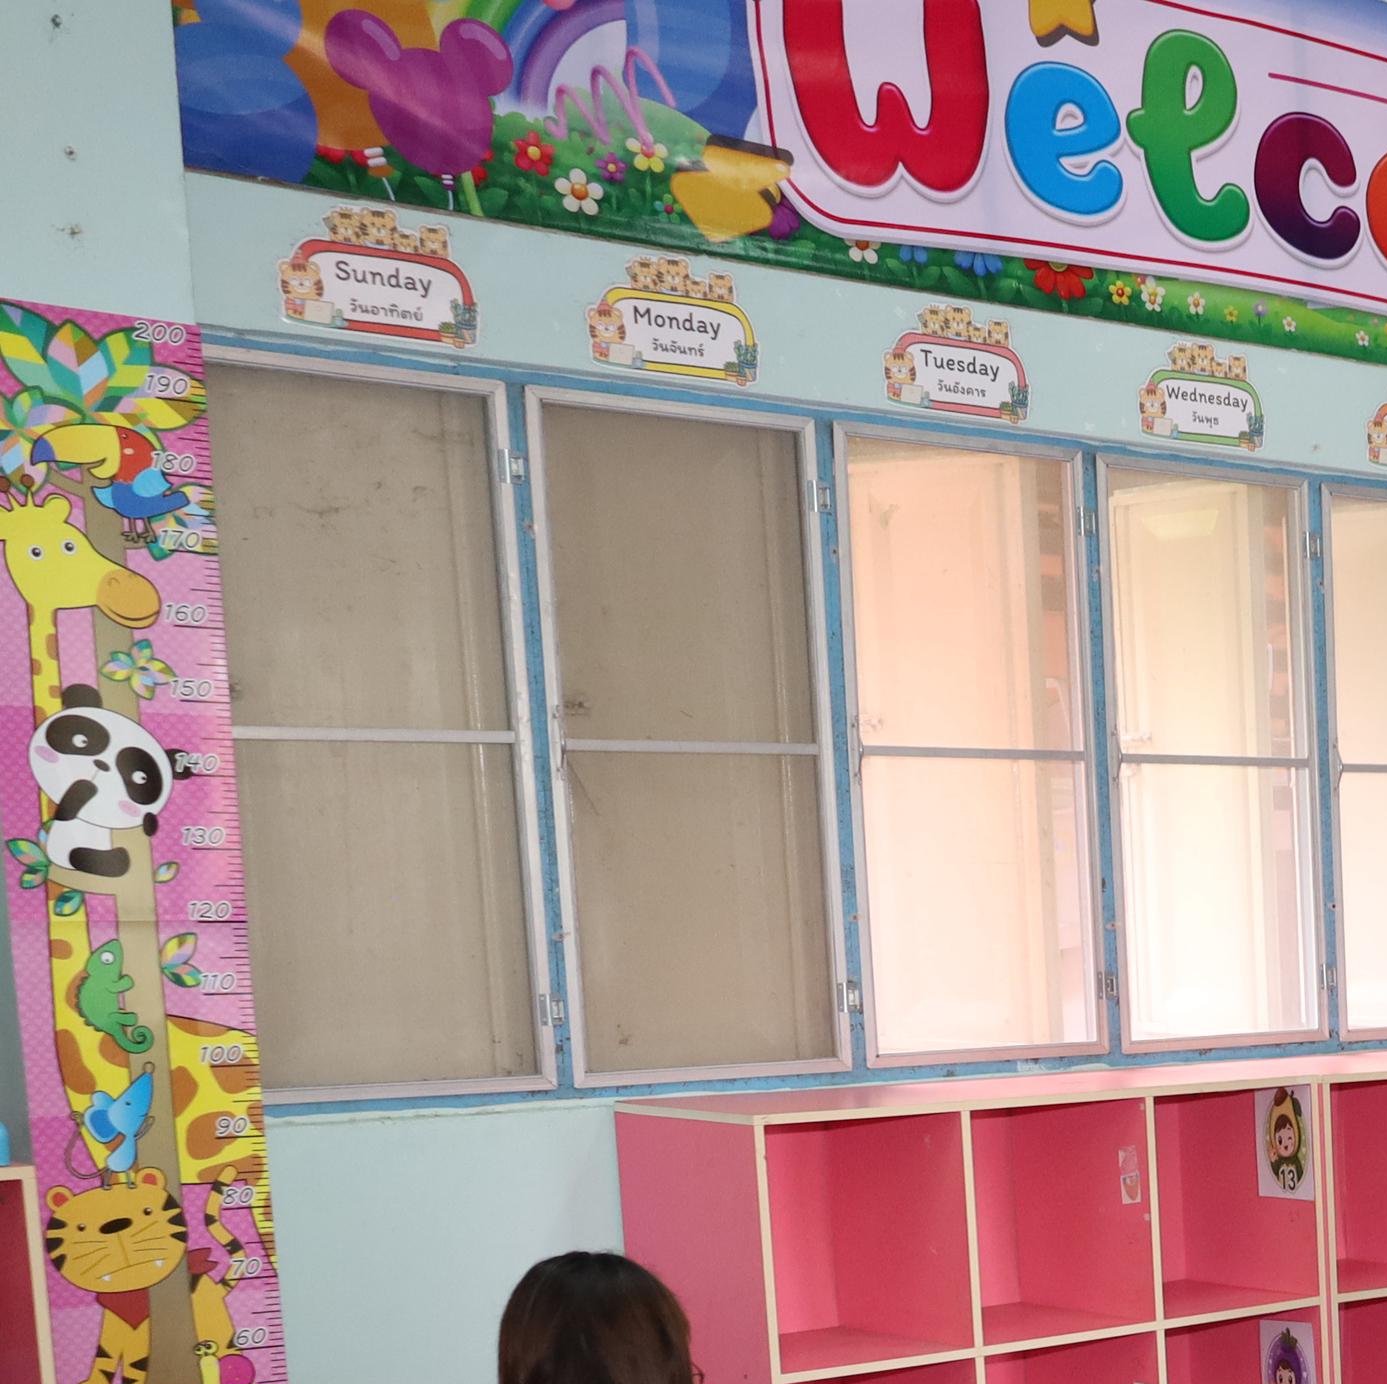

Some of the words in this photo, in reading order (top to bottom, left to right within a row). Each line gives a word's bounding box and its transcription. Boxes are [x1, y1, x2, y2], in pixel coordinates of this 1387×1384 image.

[334, 260, 432, 298] Sunday
[349, 298, 423, 322] วันอาทิตย์
[633, 305, 721, 339] Monday
[133, 322, 186, 344] 200
[652, 338, 705, 357] วันจันทร์
[920, 349, 1000, 381] Tuesday
[145, 373, 188, 395] 190
[938, 379, 986, 398] วันอังคาร
[1166, 384, 1248, 412] Wednesday
[1192, 411, 1219, 428] วันพุธ
[151, 451, 194, 473] 180
[158, 530, 200, 549] 170
[164, 604, 206, 623] 160
[170, 679, 212, 698] 150
[174, 753, 218, 773] 140
[182, 826, 225, 846] 130
[188, 901, 230, 920] 120
[200, 972, 237, 991] 110
[200, 1045, 241, 1064] 100
[215, 1117, 248, 1136] 90
[1279, 1168, 1296, 1191] 13
[222, 1187, 254, 1206] 80
[230, 1258, 262, 1277] 70
[234, 1327, 266, 1347] 60
